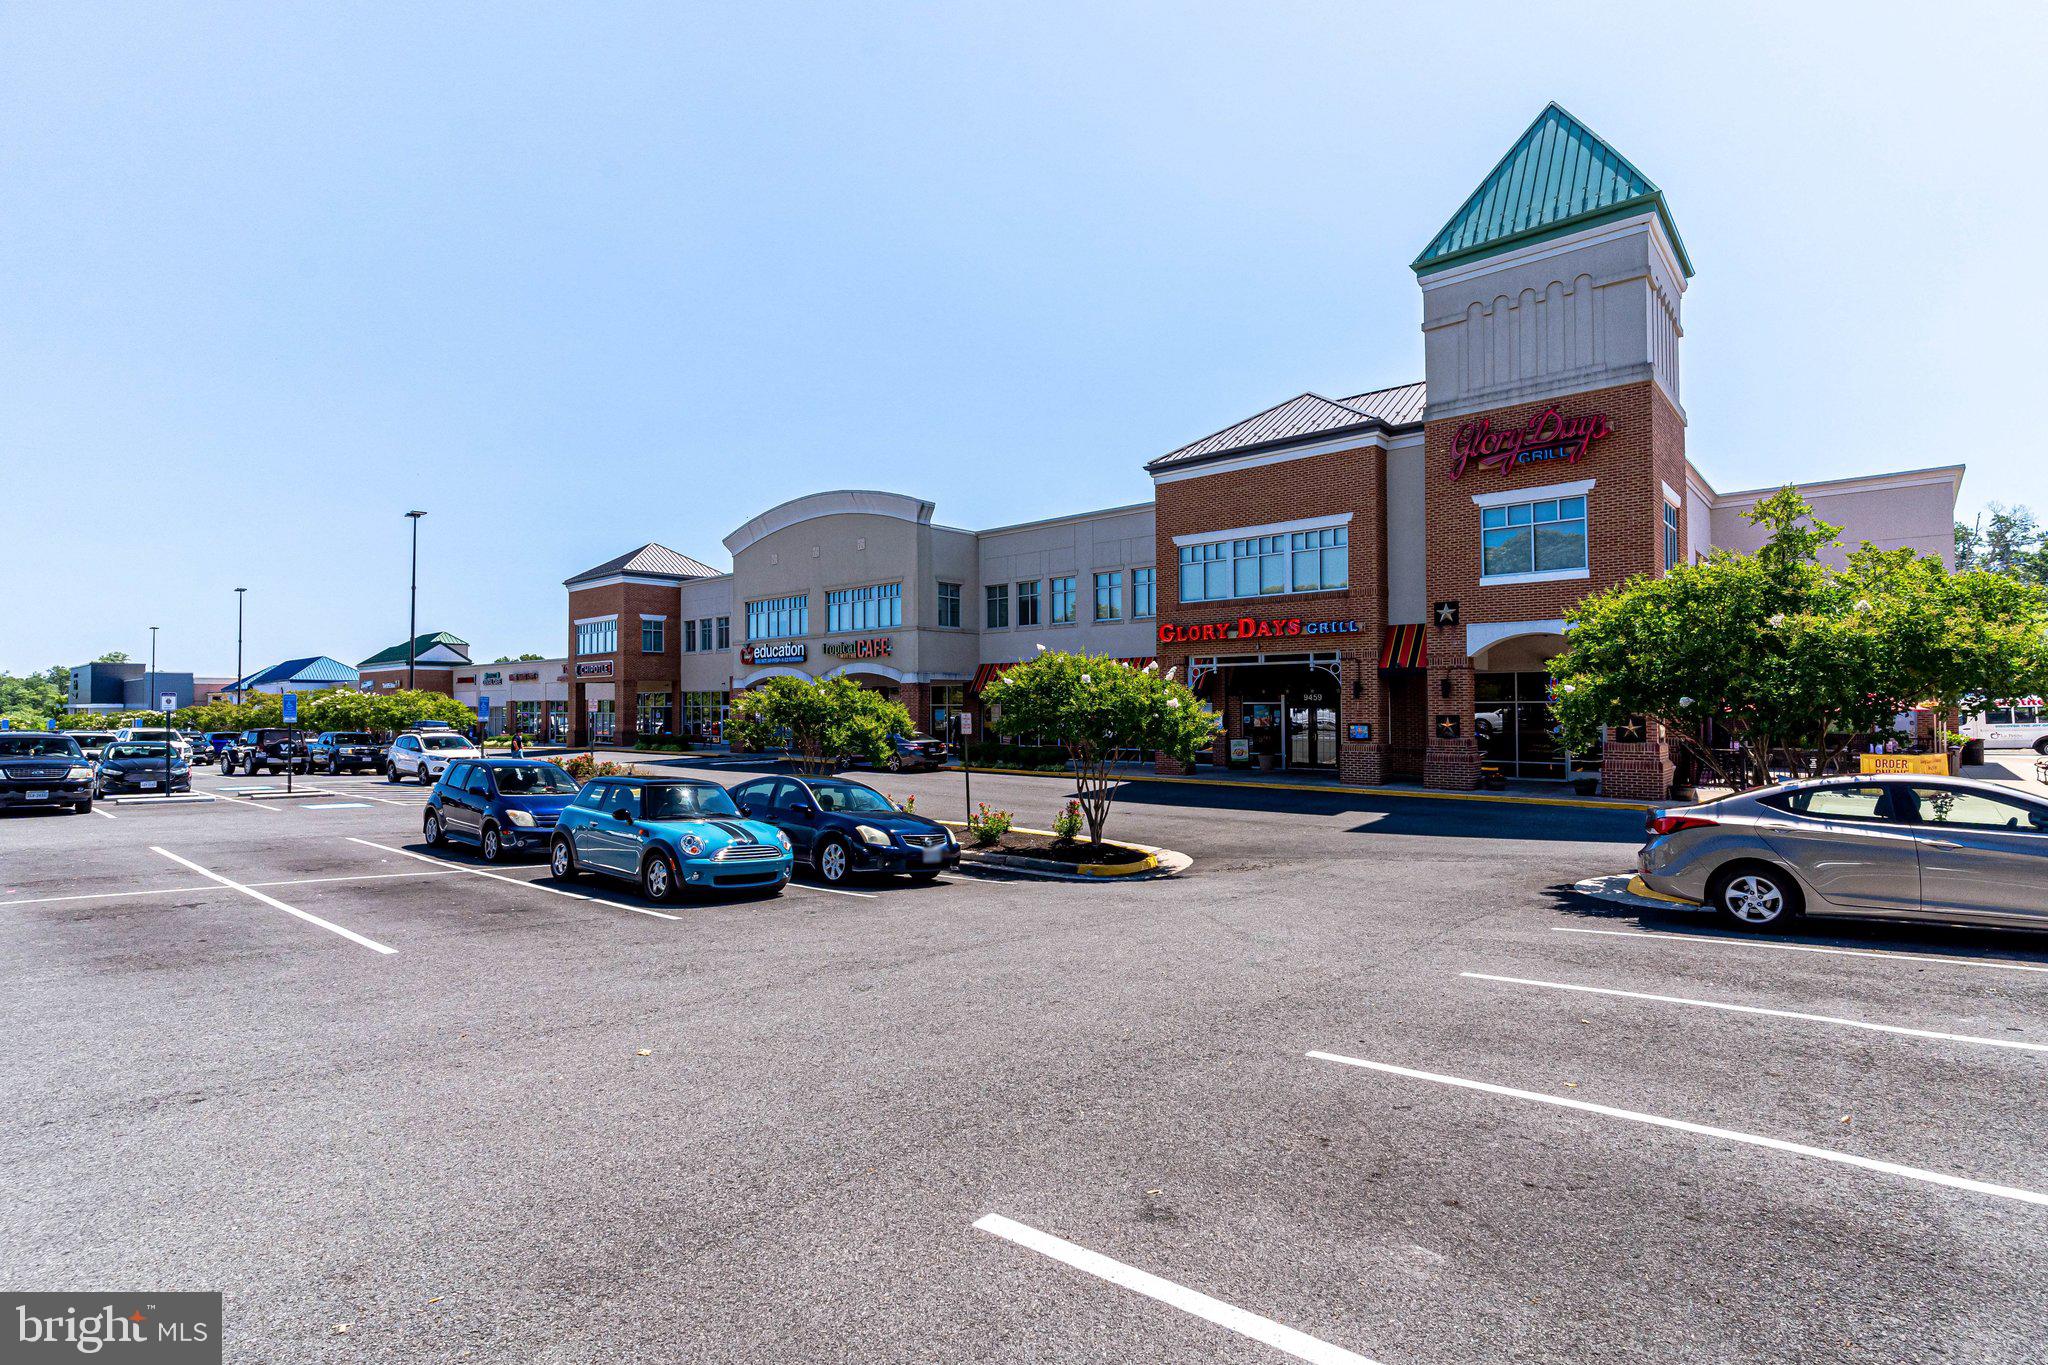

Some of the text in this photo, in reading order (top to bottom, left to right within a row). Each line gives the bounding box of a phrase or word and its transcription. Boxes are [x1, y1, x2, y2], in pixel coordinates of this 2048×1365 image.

[1450, 405, 1611, 481] Glory Days
[1517, 447, 1570, 463] GRILL
[1158, 616, 1359, 642] GLORY DAYS GRILL
[754, 642, 805, 658] education
[581, 664, 608, 674] CHIPOTLE
[1875, 759, 1908, 769] ORDER
